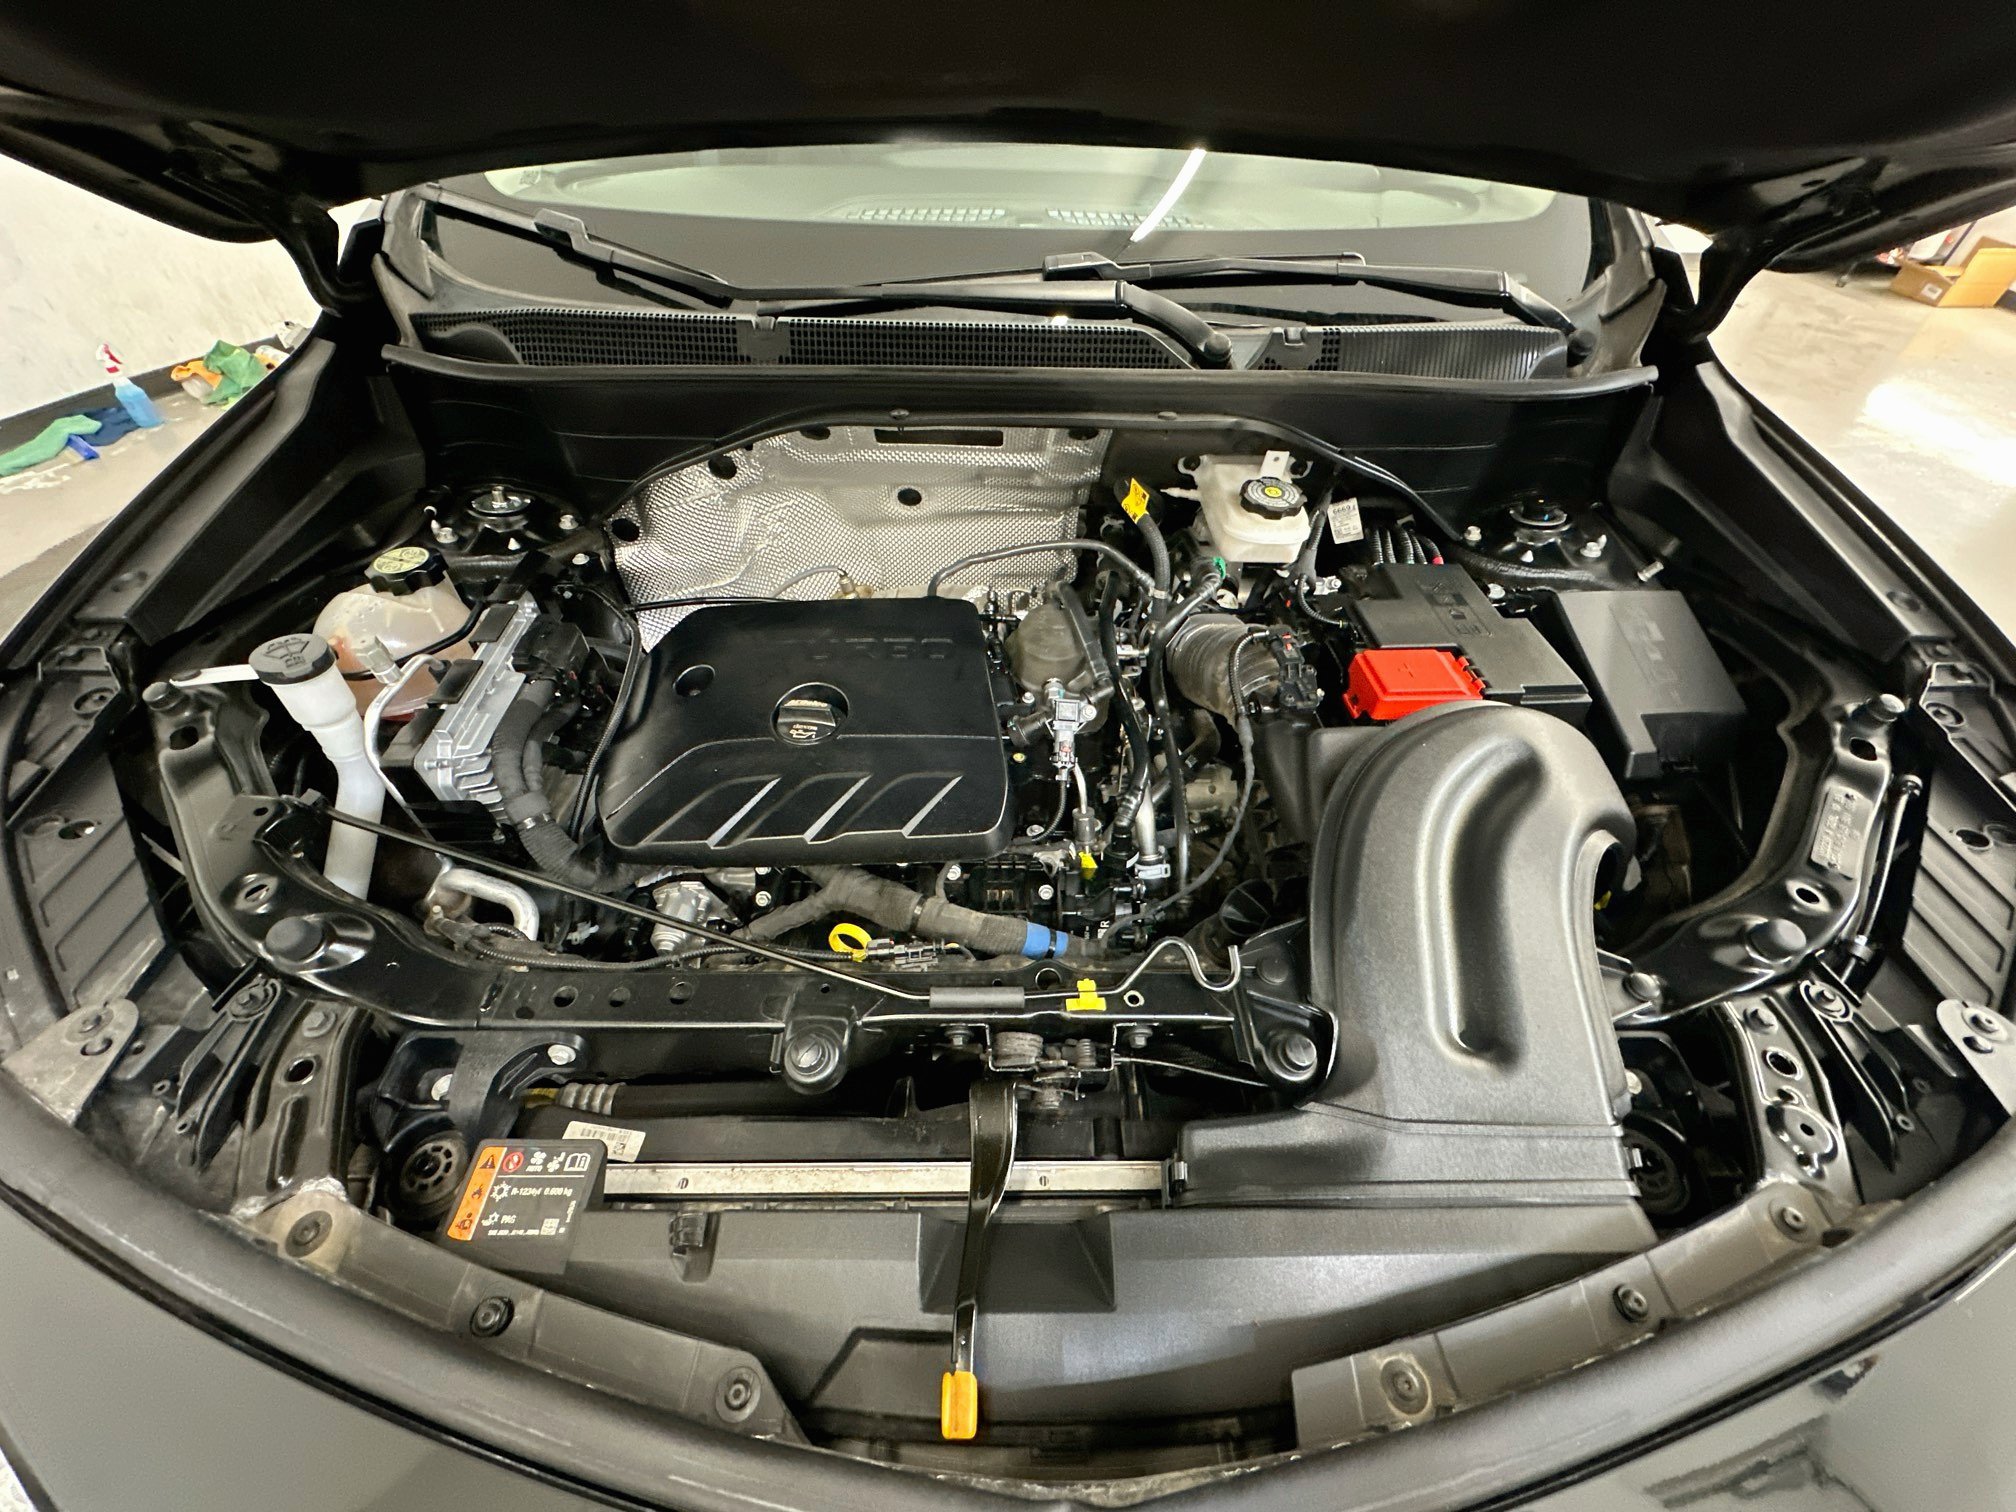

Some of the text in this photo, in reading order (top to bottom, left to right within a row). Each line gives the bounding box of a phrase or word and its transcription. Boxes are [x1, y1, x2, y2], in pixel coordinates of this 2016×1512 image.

[510, 1187, 543, 1197] R-1234yf
[563, 1187, 573, 1197] kg
[500, 1214, 517, 1224] PAG
